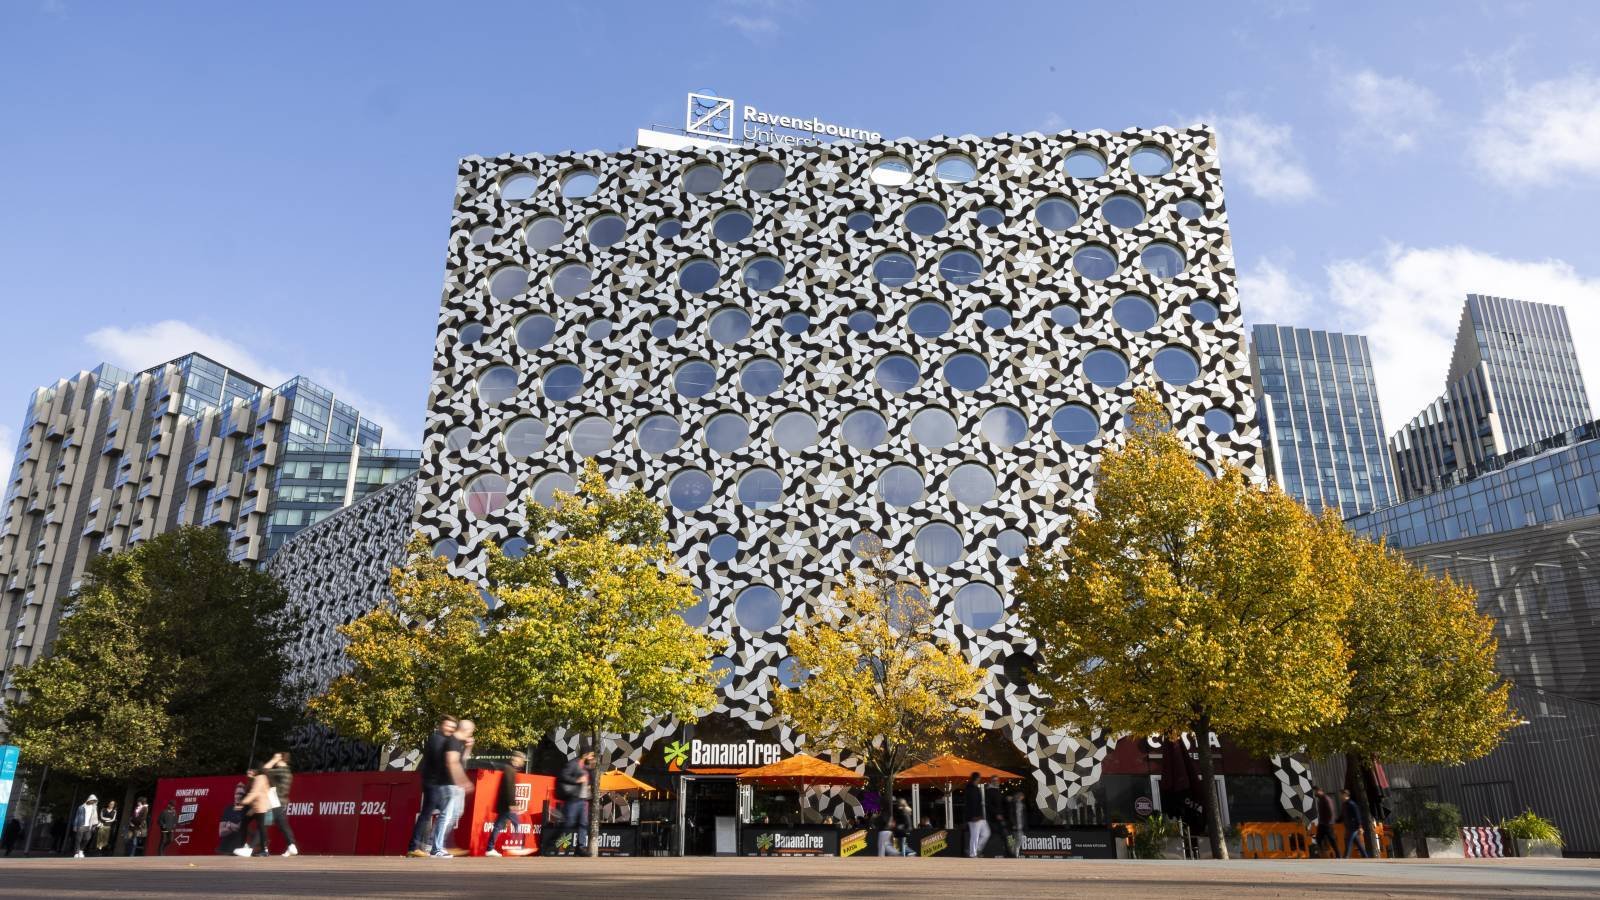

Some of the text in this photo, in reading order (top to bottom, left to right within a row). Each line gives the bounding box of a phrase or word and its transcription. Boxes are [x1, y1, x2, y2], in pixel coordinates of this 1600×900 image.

[744, 105, 881, 141] Ravensbourne
[691, 739, 781, 765] BananaTree
[286, 801, 386, 816] ENING WINTER 2024
[774, 833, 824, 849] BananaTree
[1021, 834, 1072, 850] BananaTree
